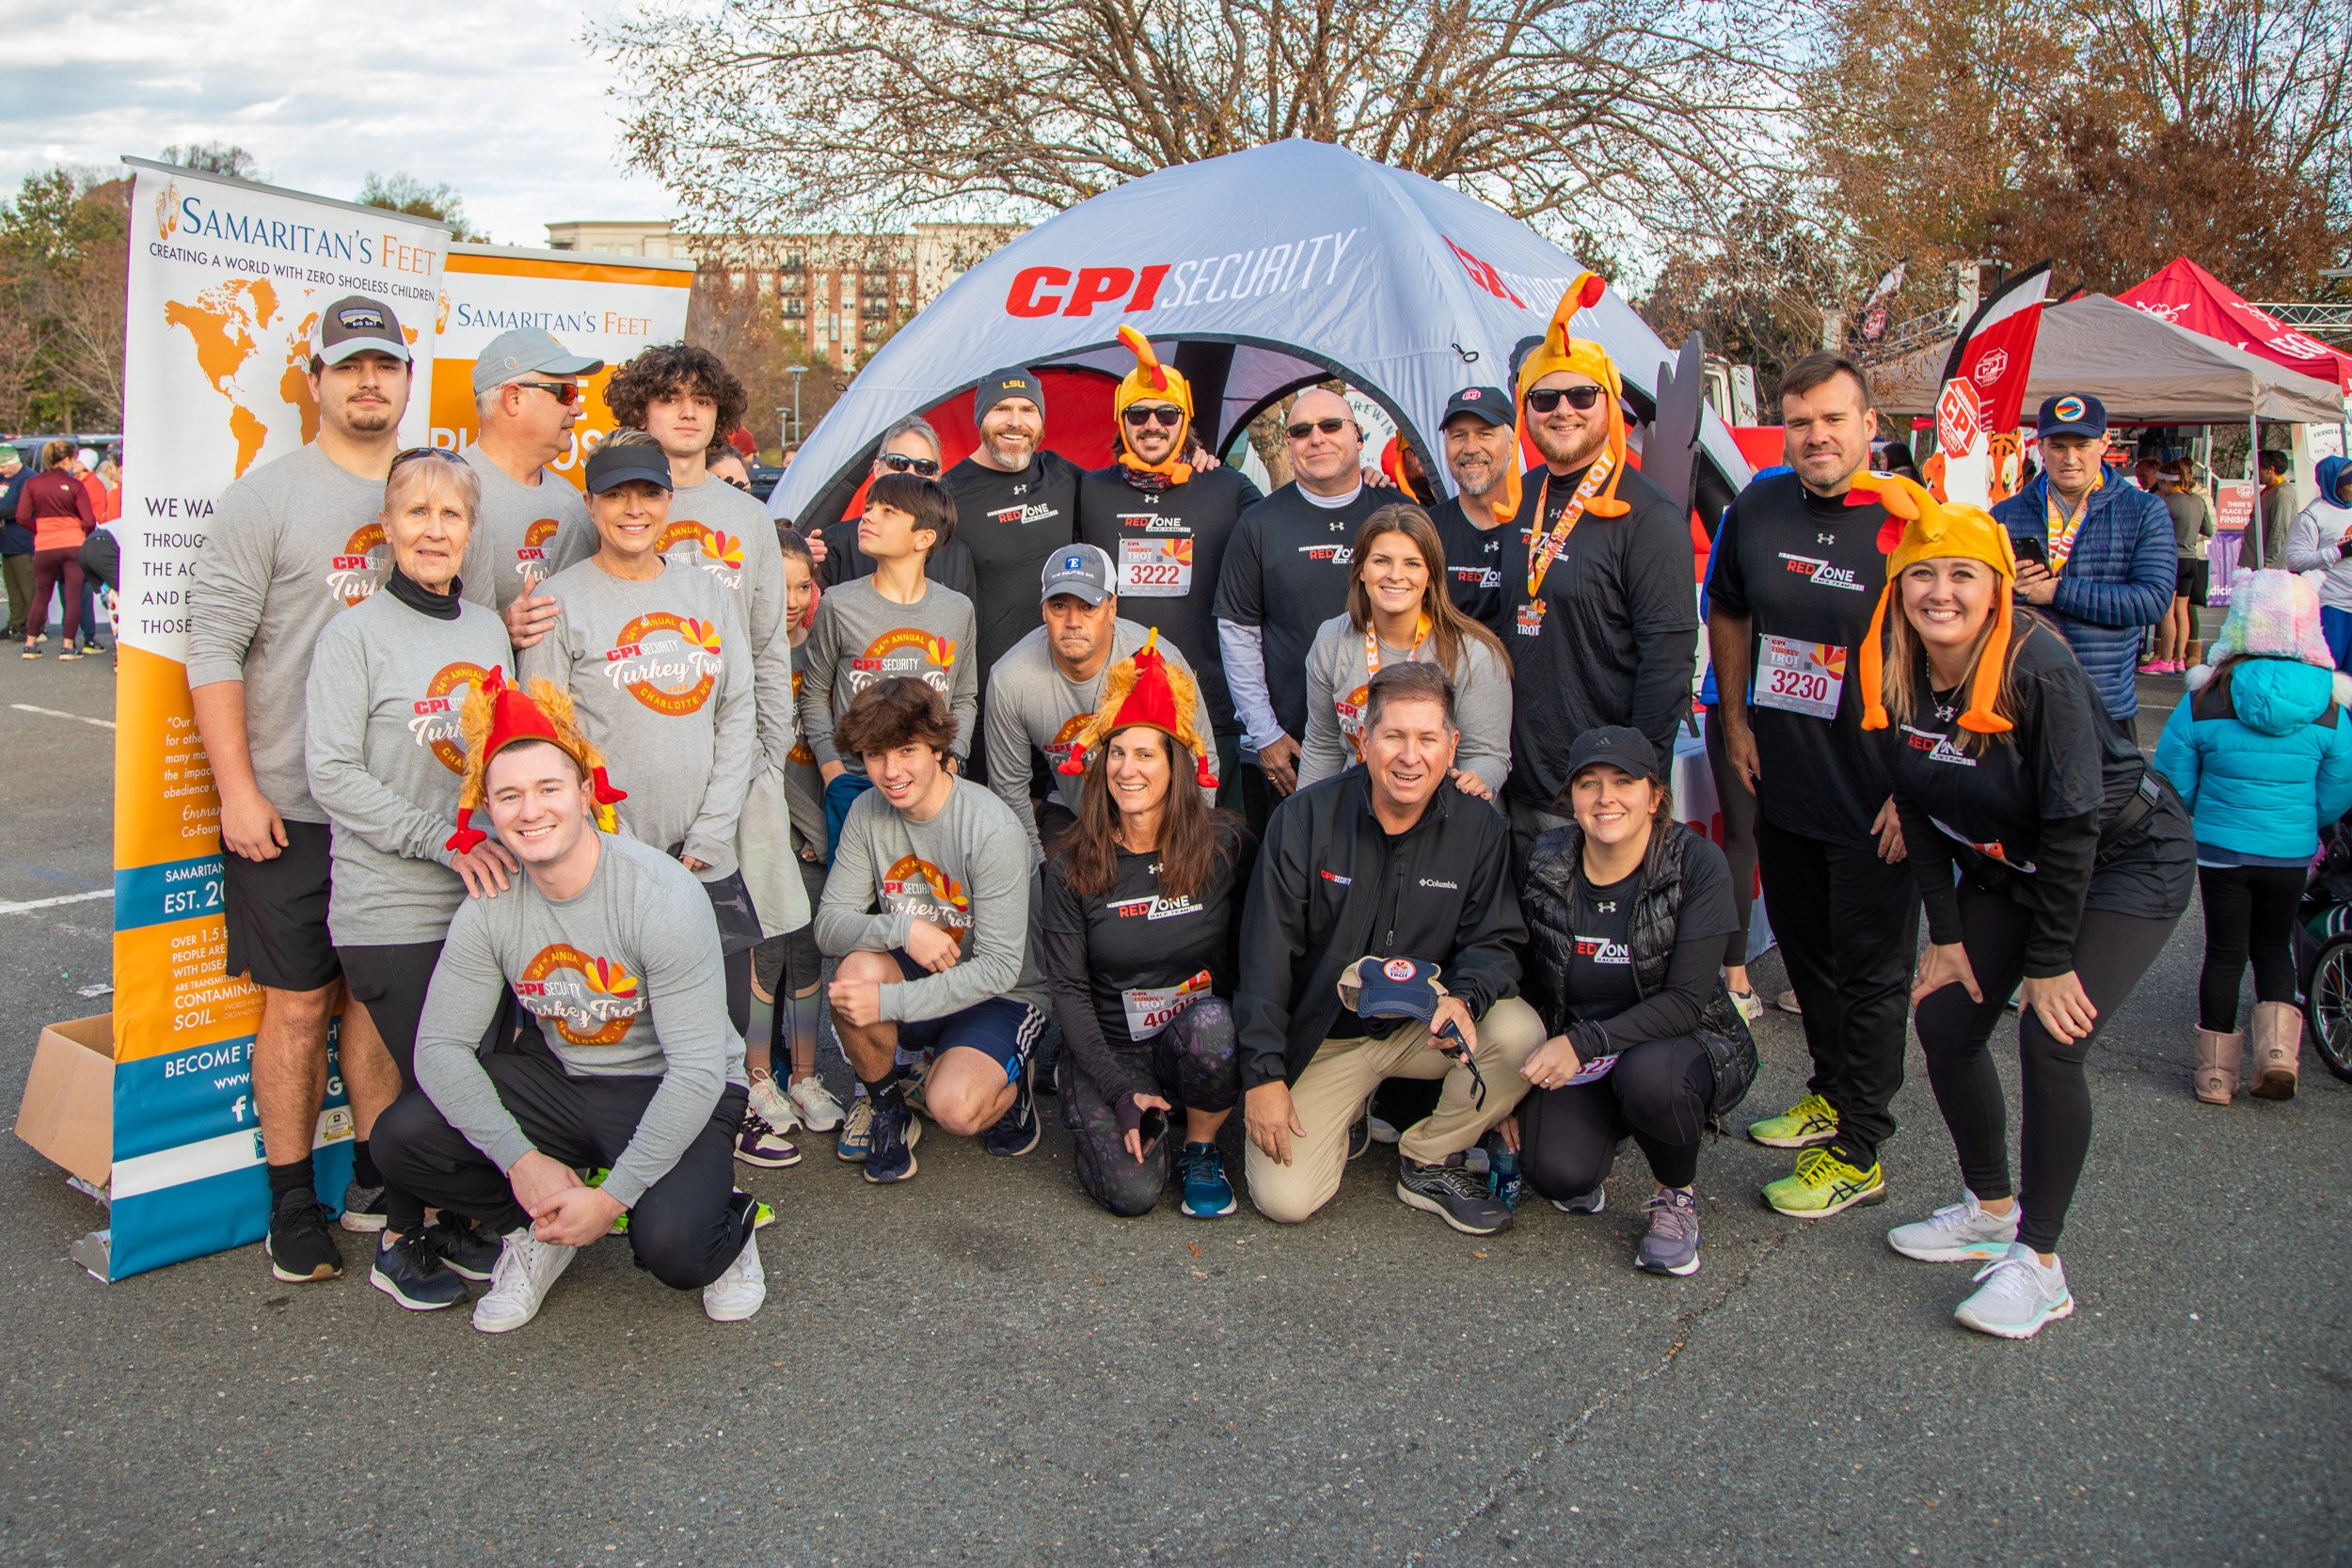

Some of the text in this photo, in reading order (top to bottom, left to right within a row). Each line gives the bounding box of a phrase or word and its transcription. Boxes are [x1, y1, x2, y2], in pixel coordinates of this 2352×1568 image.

[182, 197, 437, 276] SAMARITAN'S FEET
[150, 243, 436, 302] CREATING A WORLD WITH ZERO SHOELESS CHILDREN
[1006, 228, 1358, 318] CPI SECURITY
[458, 303, 652, 336] SAMARITAN'S FEET
[1002, 379, 1025, 389] LSU
[1955, 383, 1978, 421] WARNING
[1353, 401, 1394, 436] REWIN
[1942, 390, 1976, 448] CPI
[1940, 418, 1963, 451] SECURITY
[1570, 451, 1613, 511] TROT
[145, 497, 219, 518] WE WA
[2220, 515, 2248, 524] FINISH
[670, 526, 701, 538] ANNUAL
[516, 548, 545, 560] CPI
[1128, 552, 1152, 562] TROT
[143, 562, 172, 577] THE
[332, 556, 367, 571] CPI
[1130, 564, 1180, 584] 3222
[142, 591, 180, 605] AND
[141, 619, 192, 634] THOSE
[1517, 624, 1542, 636] TROT
[606, 640, 678, 661] CPI SECURITY
[873, 633, 925, 656] 34TH ANNUAL
[1772, 646, 1800, 657] TURKEY
[852, 657, 918, 672] CPI SECURITY
[1771, 653, 1800, 666] TROT
[452, 668, 484, 680] ANNUAL
[603, 651, 723, 690] Turkey Trot
[1771, 669, 1828, 702] 3230
[640, 681, 710, 710] CHARLOTTE NC
[414, 698, 451, 715] CPI
[1336, 702, 1358, 720] CPI
[166, 734, 179, 747] for
[166, 753, 190, 765] many
[164, 770, 179, 782] the
[164, 784, 209, 799] obedience
[884, 882, 902, 895] PI
[1426, 879, 1458, 890] Columbia
[165, 890, 200, 913] EST.
[1150, 911, 1168, 919] RACE
[171, 927, 219, 948] OVER 1.5
[172, 943, 226, 963] PEOPLE ARE
[173, 964, 199, 978] WITH
[532, 957, 548, 978] 34TH
[175, 983, 189, 992] ARE
[224, 1000, 247, 1010] WORLD
[590, 994, 649, 1022] Trot
[1134, 1000, 1166, 1009] TROT
[173, 1008, 216, 1032] SOIL.
[165, 1046, 241, 1079] BECOME
